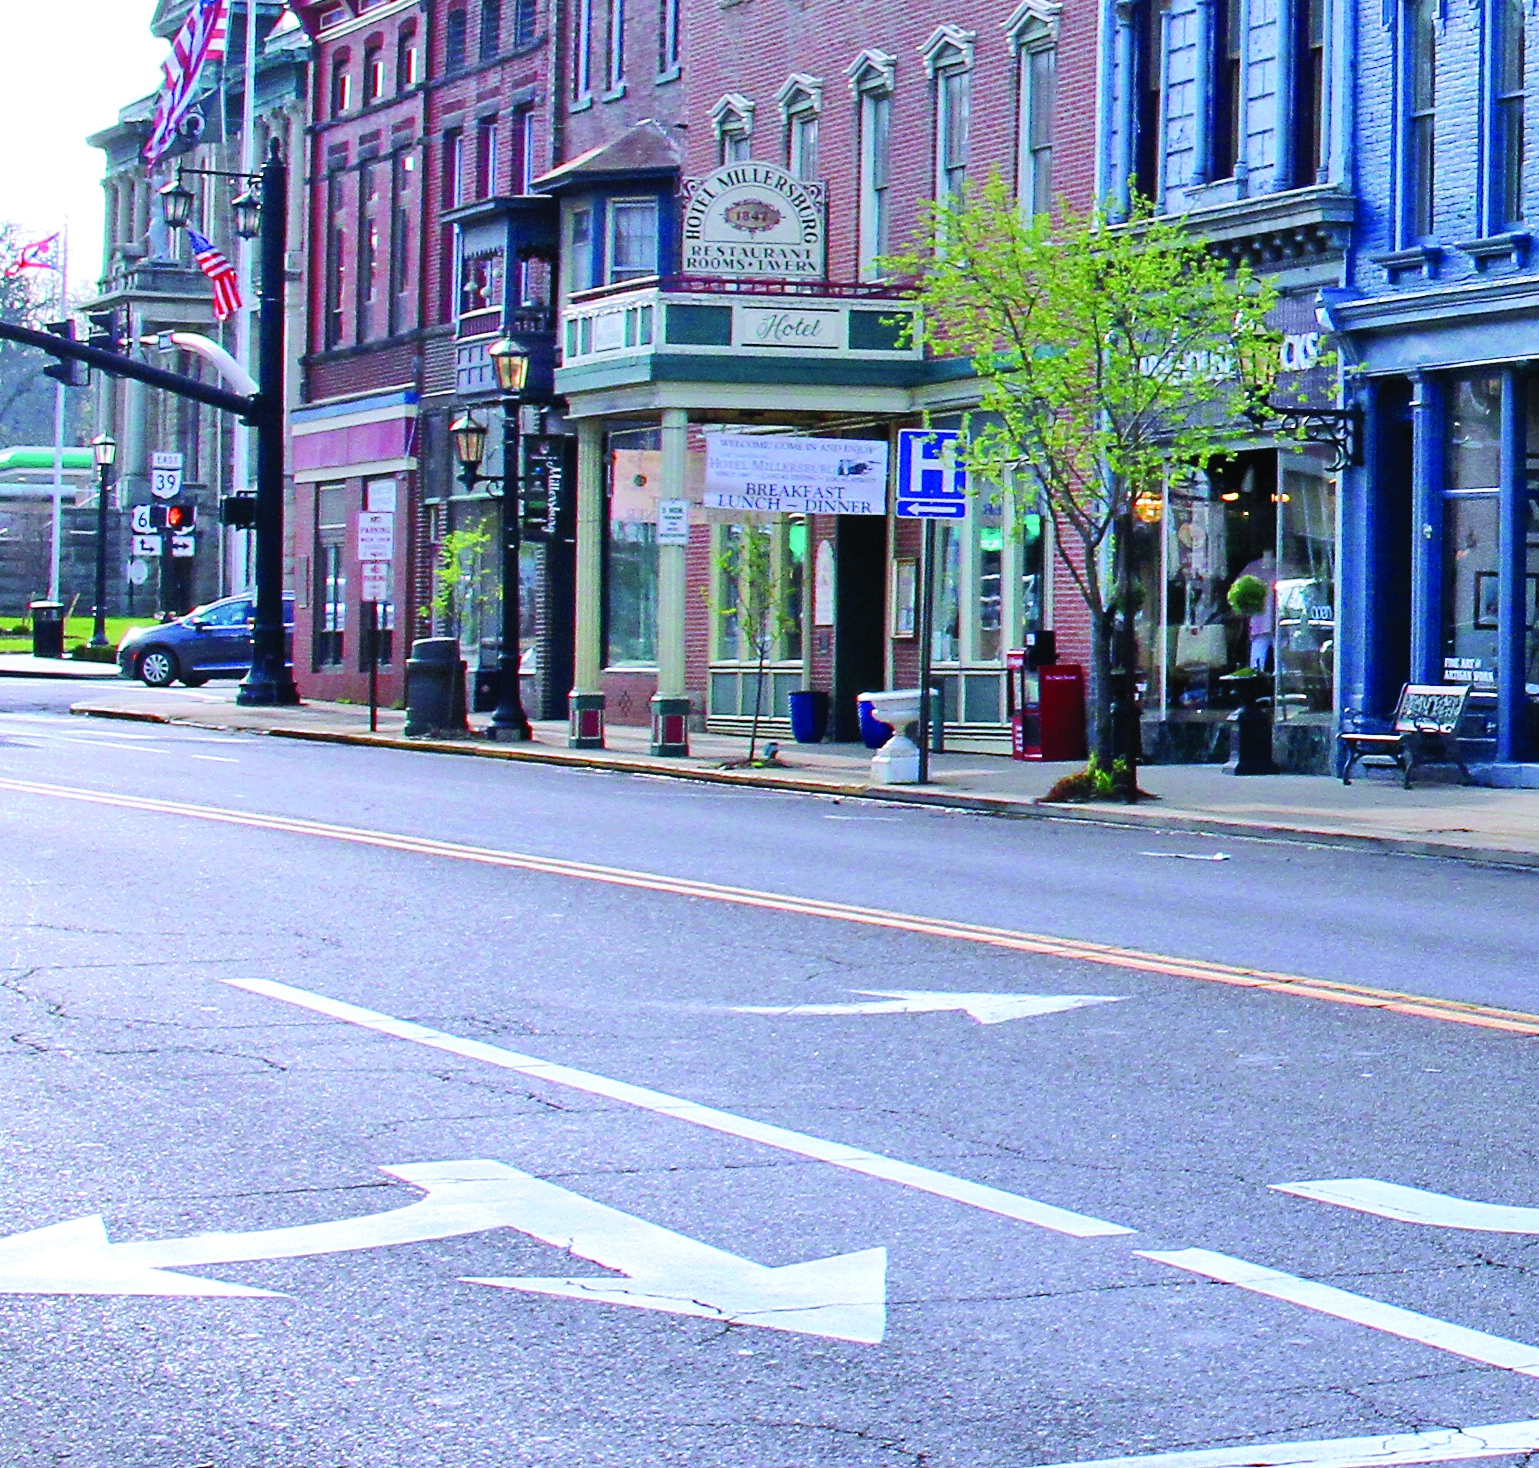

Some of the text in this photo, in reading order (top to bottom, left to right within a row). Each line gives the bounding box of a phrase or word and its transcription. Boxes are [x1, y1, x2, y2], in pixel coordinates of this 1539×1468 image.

[685, 167, 819, 244] HOTEL MILLERSBURG
[691, 245, 812, 260] RESTAURANT
[686, 258, 817, 272] ROOMS TAVERN
[756, 313, 824, 341] Hotel
[910, 439, 956, 492] H
[156, 474, 175, 491] 39
[745, 483, 846, 499] BREAKFAST
[718, 494, 872, 513] LUNCH DINNER
[1460, 658, 1474, 668] ART
